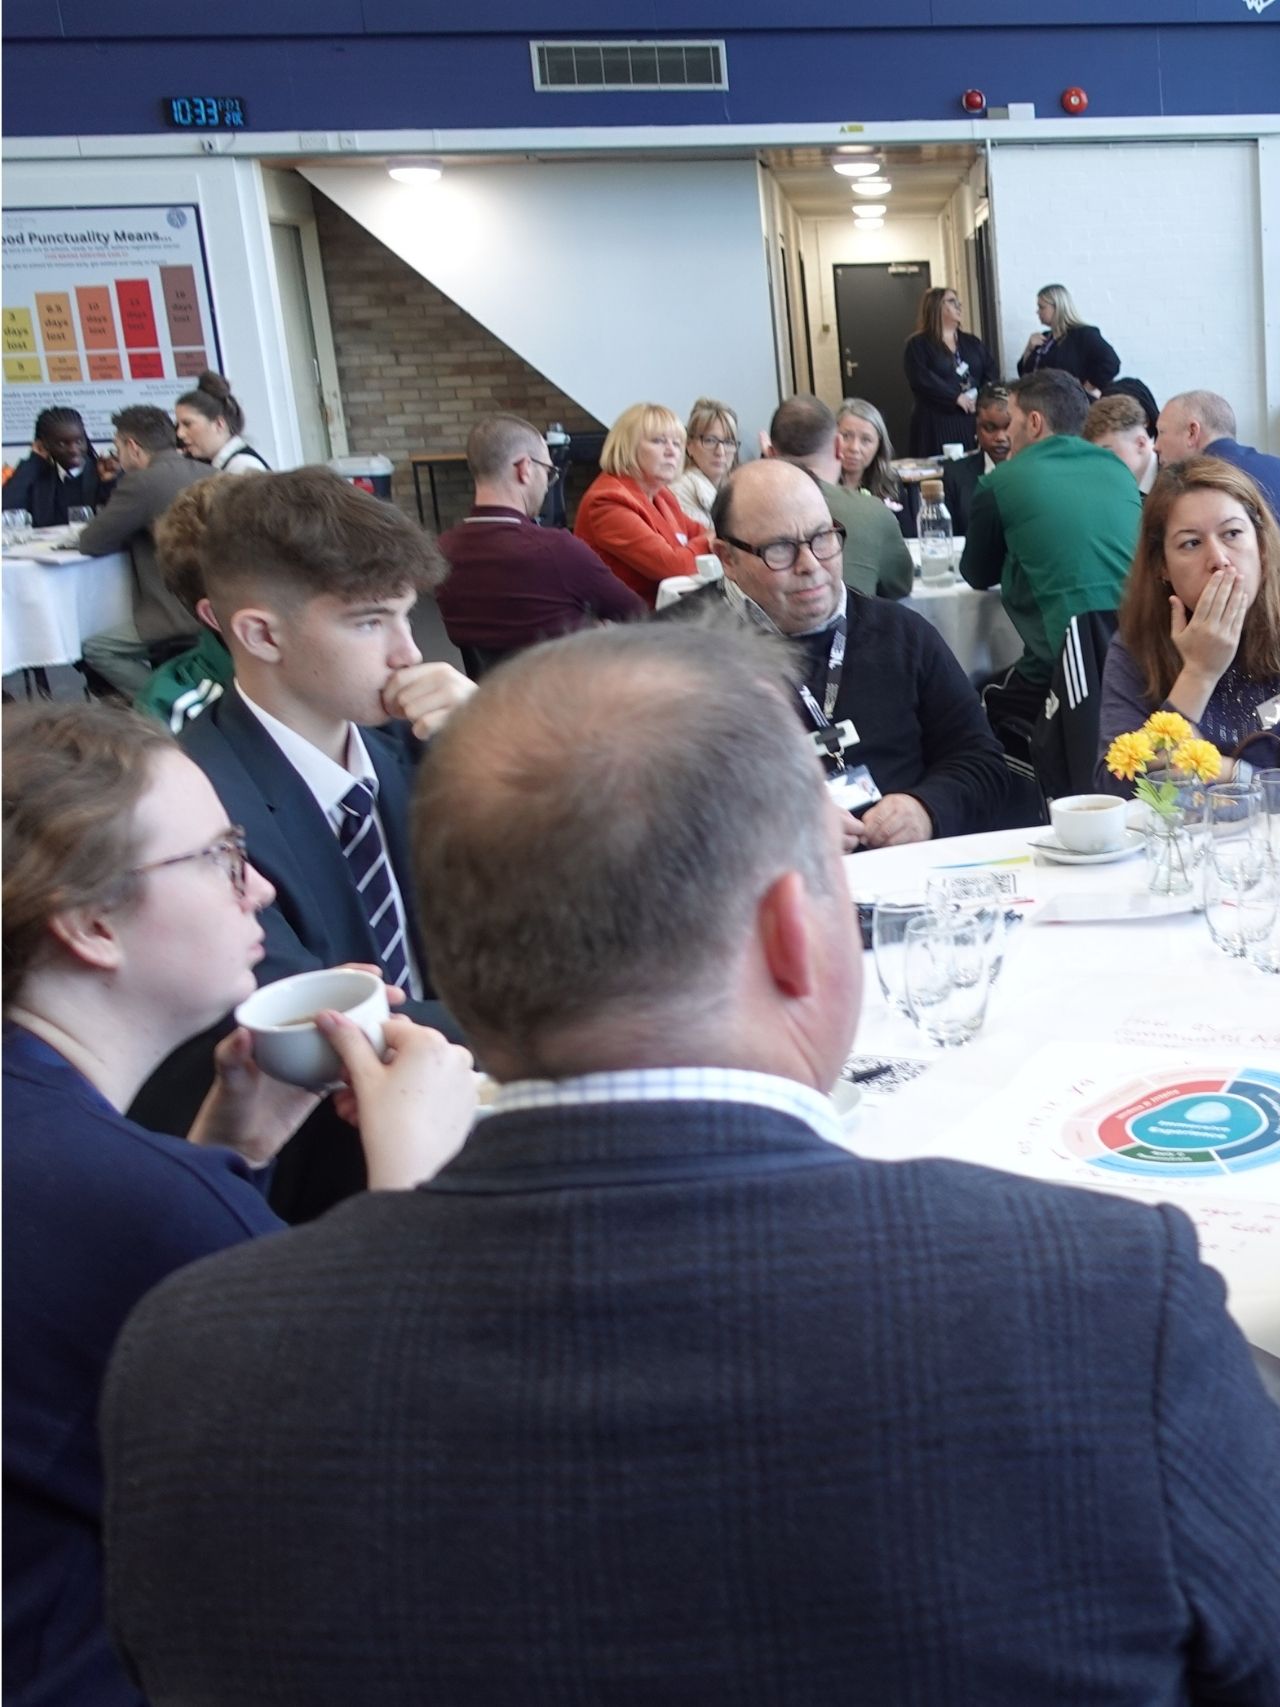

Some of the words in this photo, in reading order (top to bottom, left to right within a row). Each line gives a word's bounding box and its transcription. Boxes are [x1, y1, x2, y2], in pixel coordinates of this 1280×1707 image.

[28, 229, 110, 246] Punctuality
[44, 319, 69, 329] days
[4, 326, 29, 338] days
[46, 331, 66, 342] lost
[7, 339, 27, 350] lost
